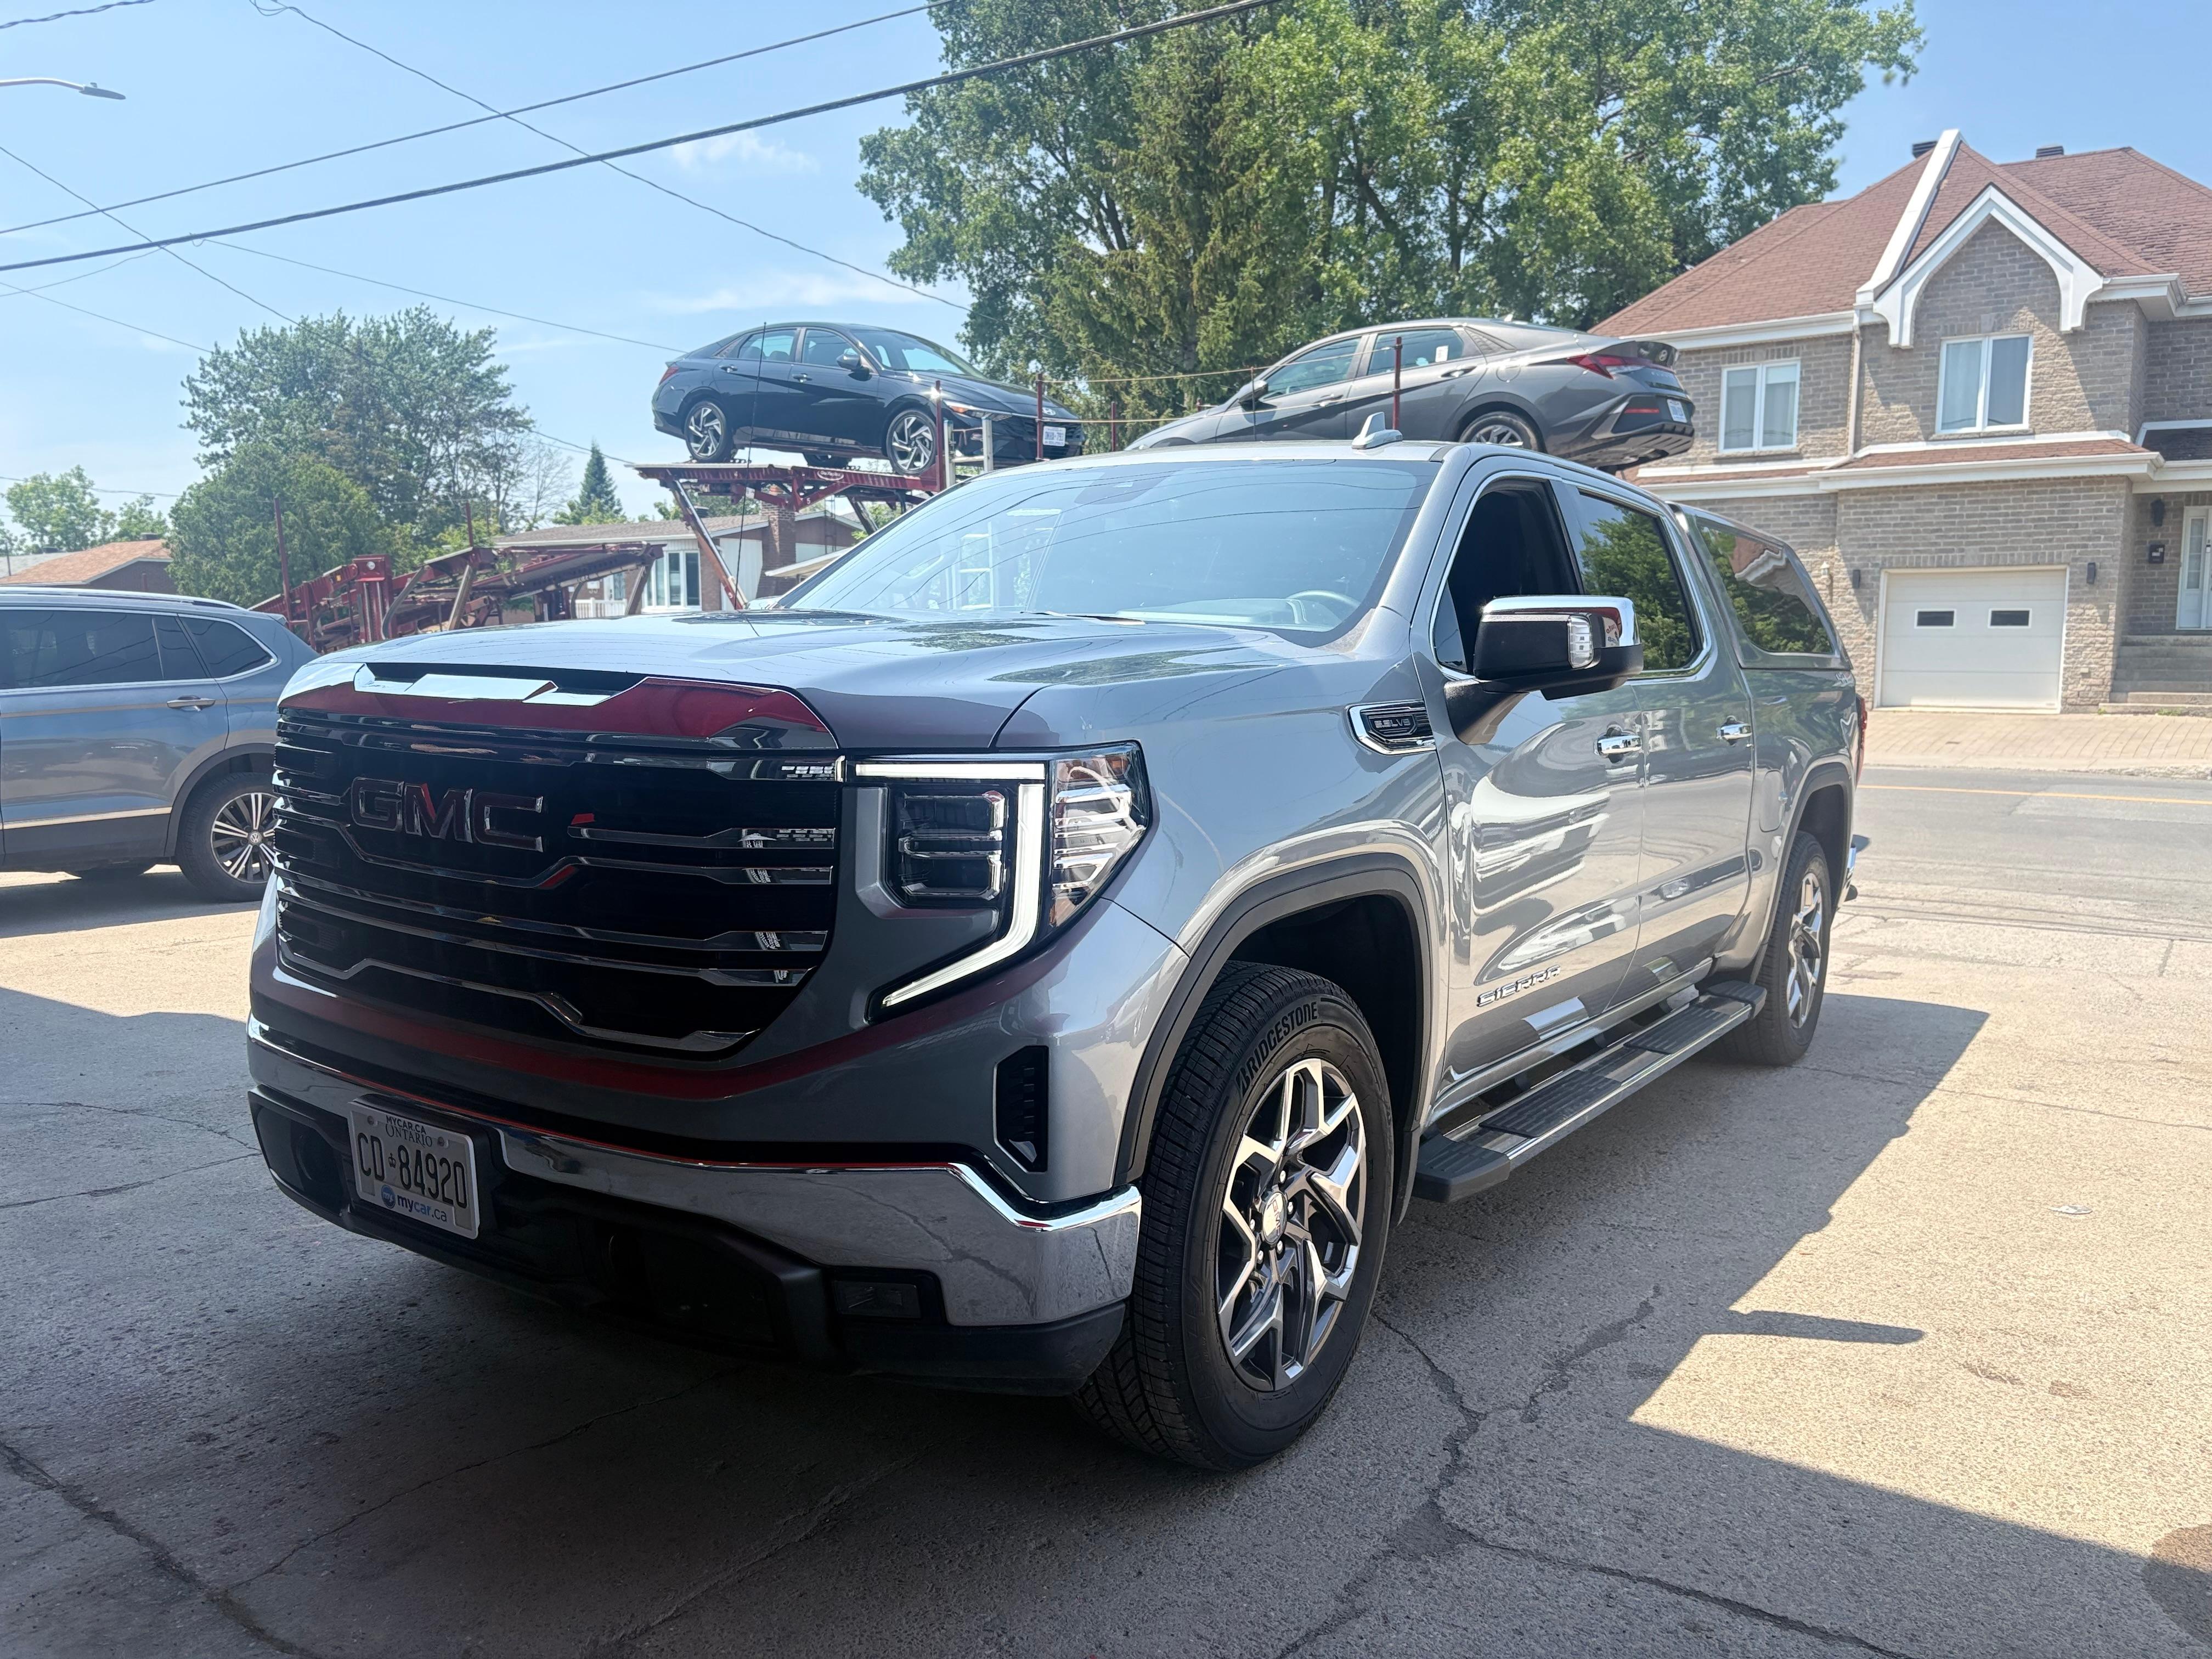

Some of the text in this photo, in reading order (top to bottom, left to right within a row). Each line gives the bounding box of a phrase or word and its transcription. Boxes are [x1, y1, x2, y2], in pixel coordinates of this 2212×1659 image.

[351, 776, 543, 853] GMC
[1476, 964, 1561, 1007] SIERRA
[1235, 1001, 1318, 1097] BRIDGESTONE
[386, 1115, 426, 1135] MYCAR.CA
[386, 1124, 432, 1148] ONTARIO
[358, 1132, 466, 1209] CD 84920
[397, 1195, 447, 1223] mycar.ca
